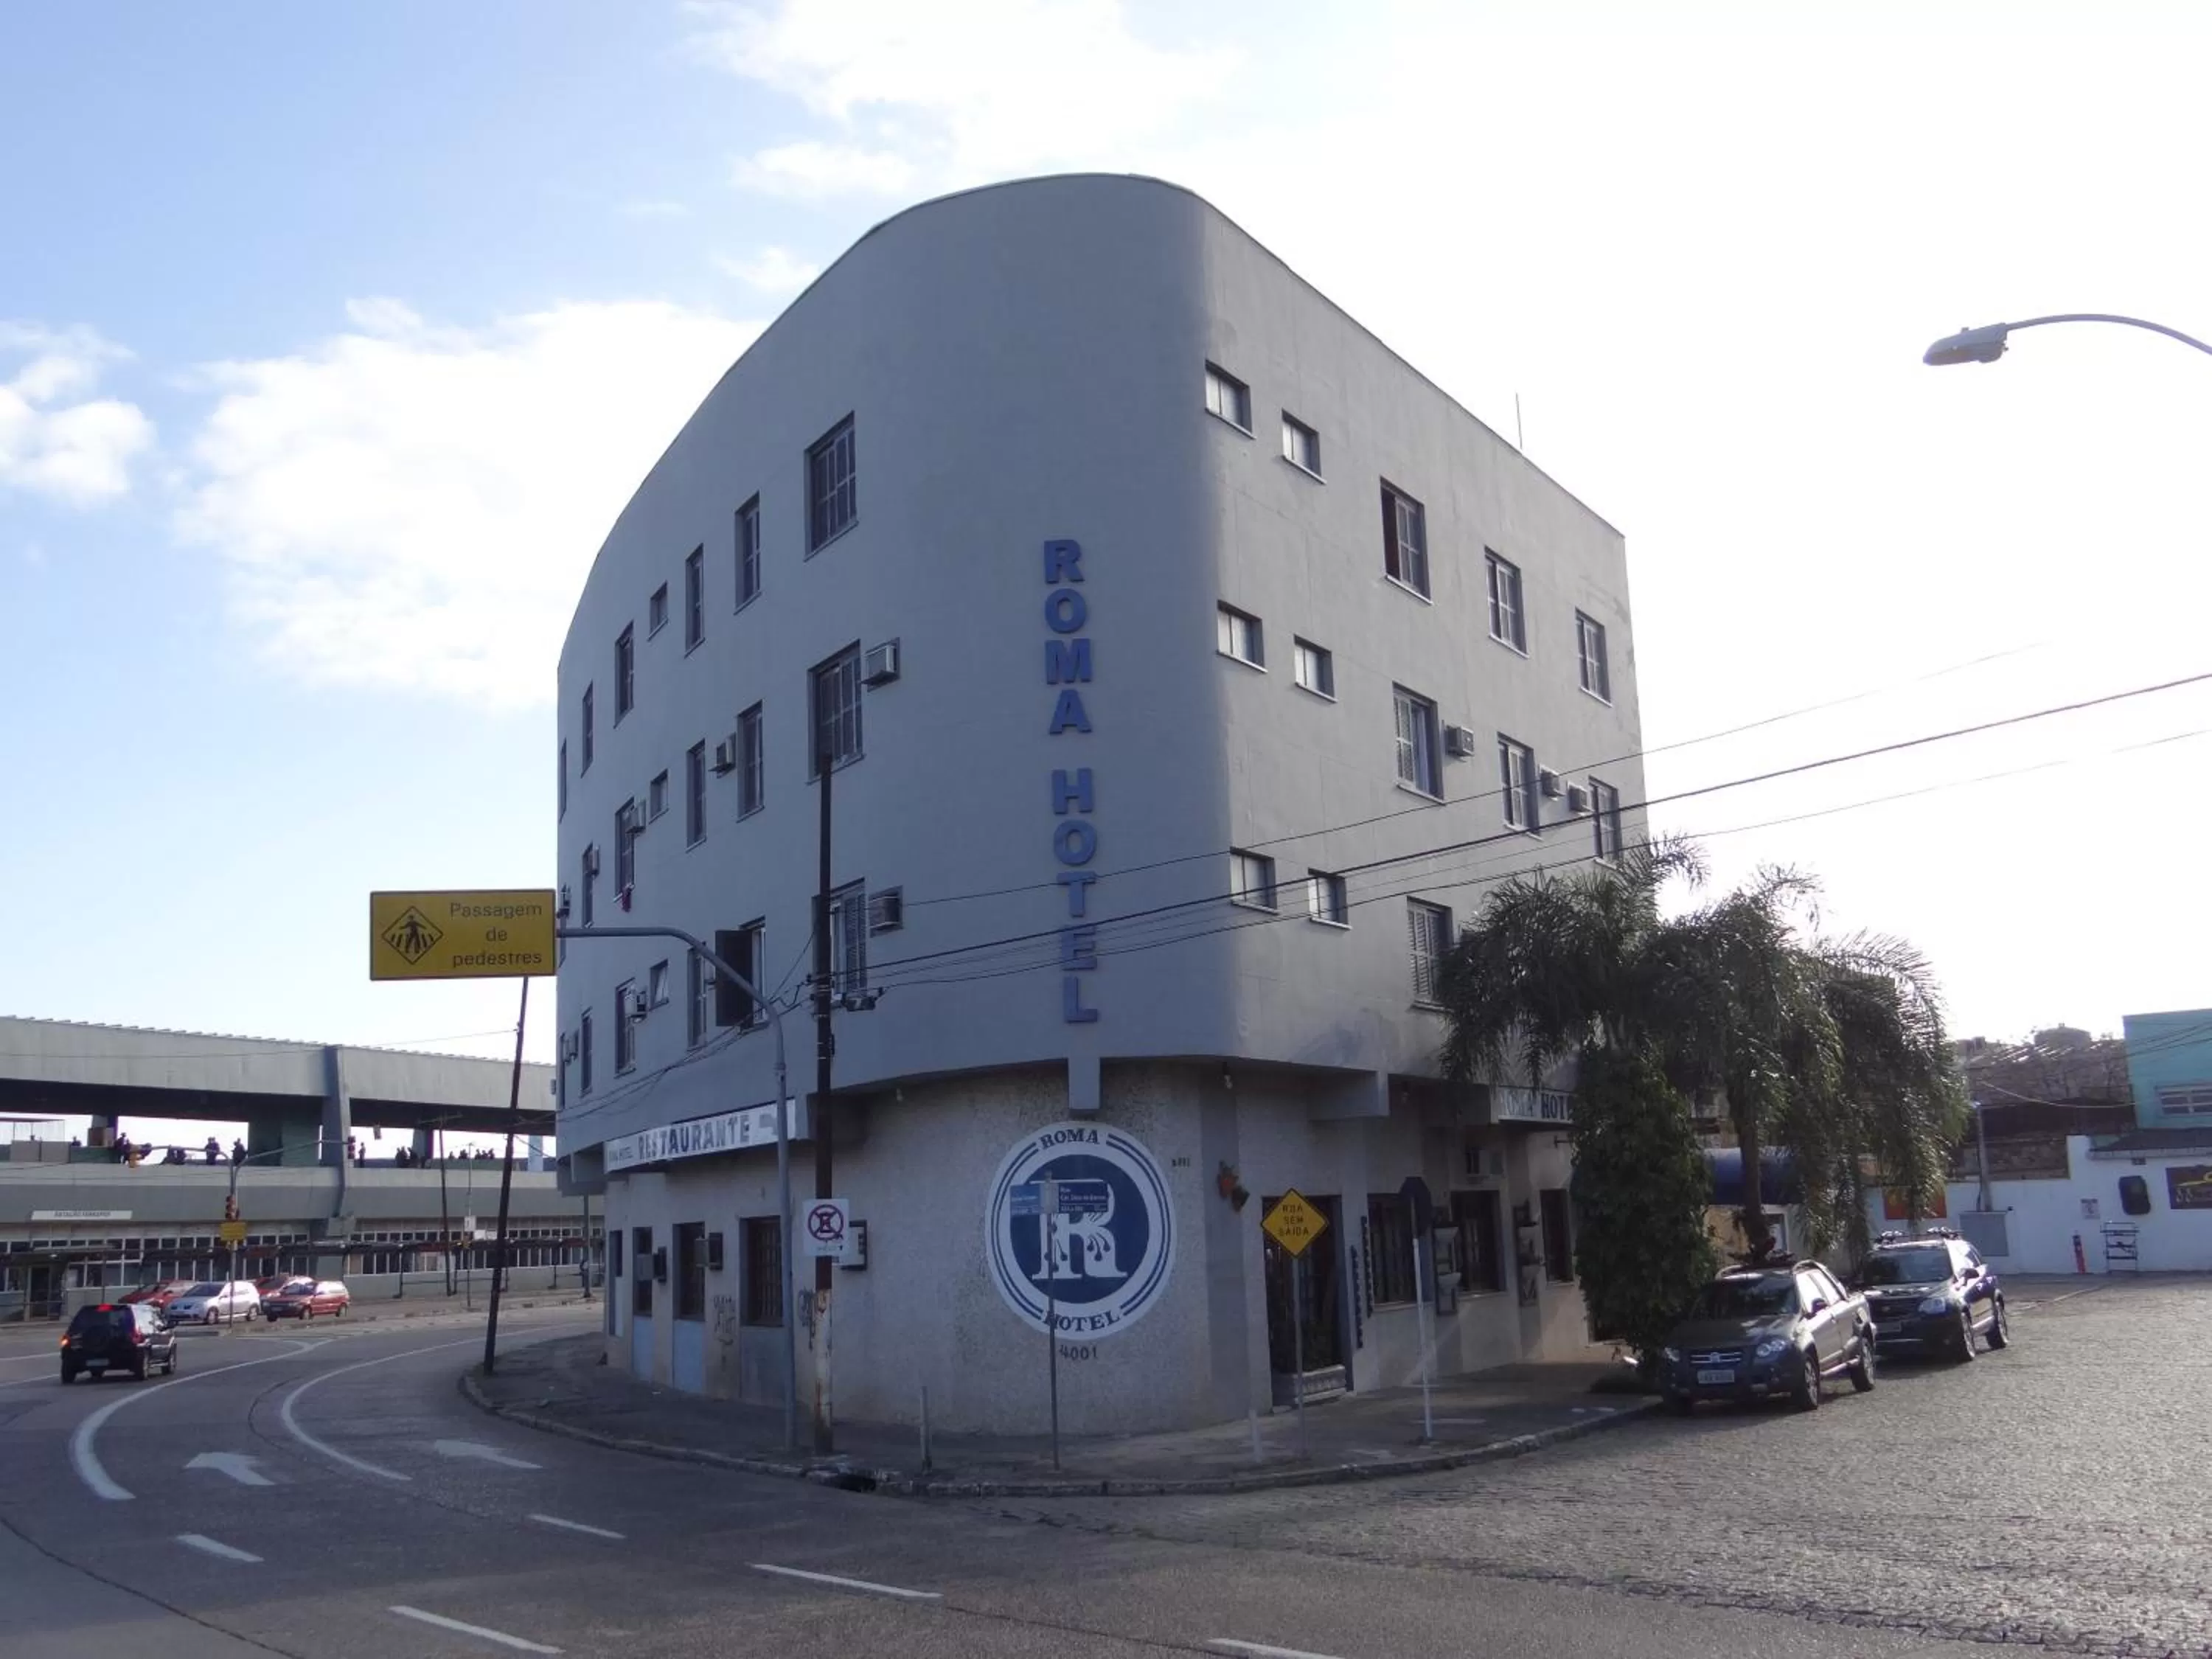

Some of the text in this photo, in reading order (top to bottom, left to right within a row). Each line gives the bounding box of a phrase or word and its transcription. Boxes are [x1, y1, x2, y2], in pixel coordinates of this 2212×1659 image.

[1043, 539, 1099, 1023] ROMA HOTEL
[451, 902, 543, 919] Passagem
[485, 926, 508, 942] de
[453, 951, 543, 968] pedestres
[637, 1113, 751, 1161] RESTAURANTE
[1038, 1127, 1100, 1149] ROMA
[1282, 1203, 1303, 1214] RUA
[1284, 1215, 1304, 1225] SEM
[1043, 1310, 1121, 1332] HOTEL
[1060, 1344, 1098, 1361] 4001
